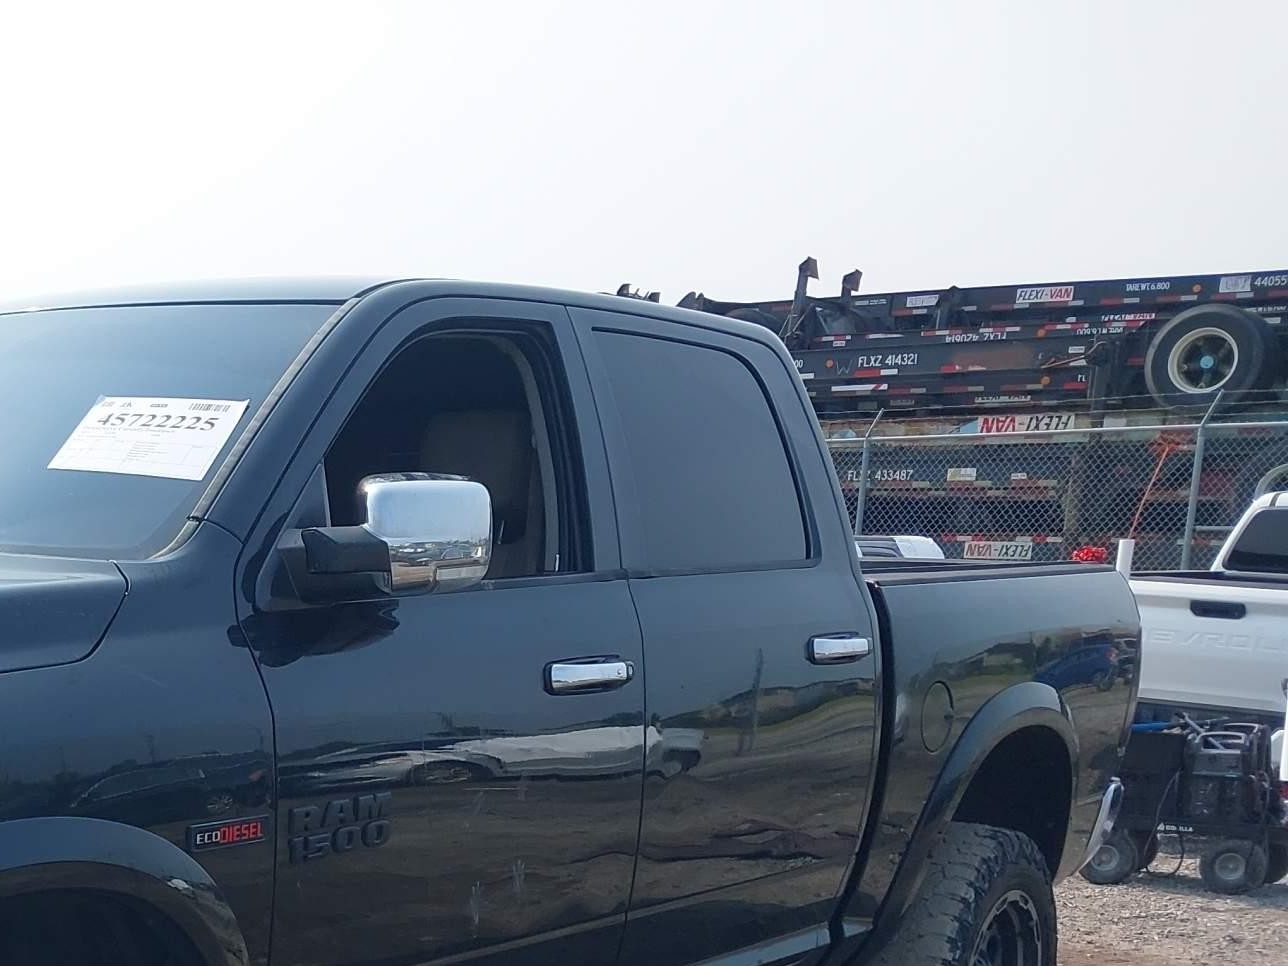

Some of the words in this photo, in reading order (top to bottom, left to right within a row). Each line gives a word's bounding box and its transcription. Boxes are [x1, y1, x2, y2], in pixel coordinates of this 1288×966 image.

[1016, 287, 1073, 301] FLEXI-VAN
[858, 355, 882, 368] FLXZ
[884, 354, 918, 367] 414321
[97, 412, 220, 432] 45722225
[979, 414, 1072, 433] FLEXI-VAN
[875, 469, 914, 481] 433487
[965, 543, 1030, 558] FLEXI-VAN
[287, 792, 393, 834] RAM
[287, 818, 393, 864] 1500
